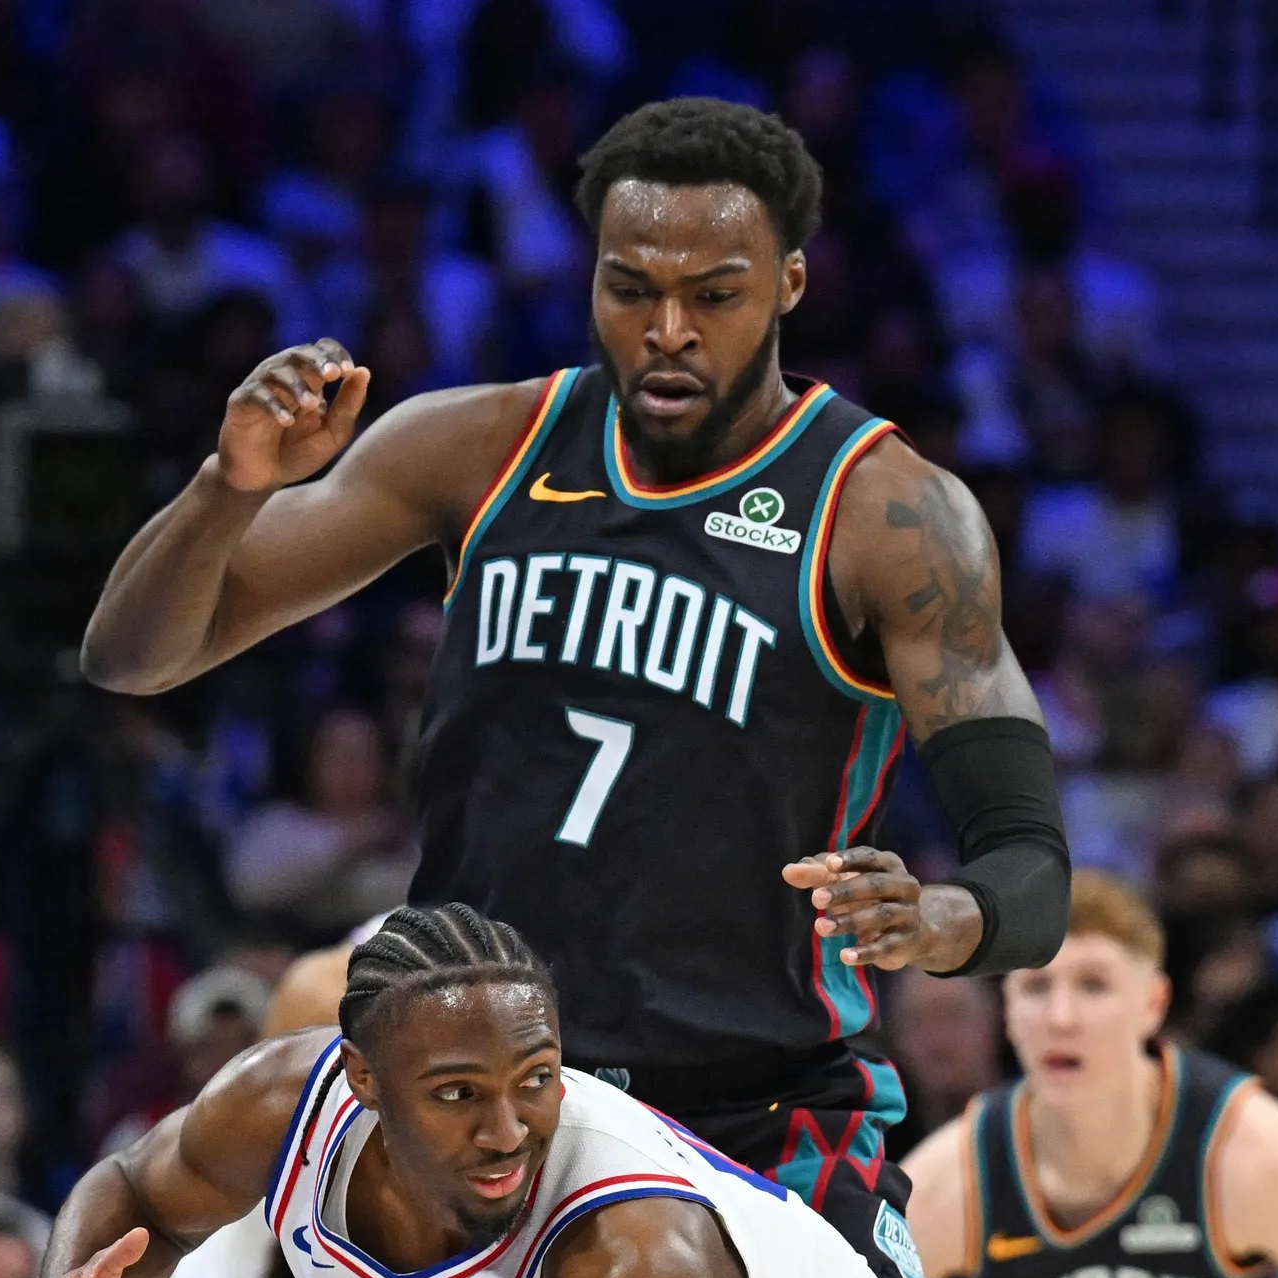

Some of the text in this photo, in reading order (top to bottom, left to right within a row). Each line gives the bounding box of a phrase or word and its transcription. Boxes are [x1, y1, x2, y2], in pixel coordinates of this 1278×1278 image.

[708, 516, 796, 549] StockX
[474, 551, 778, 730] DETROIT
[554, 705, 636, 849] 7
